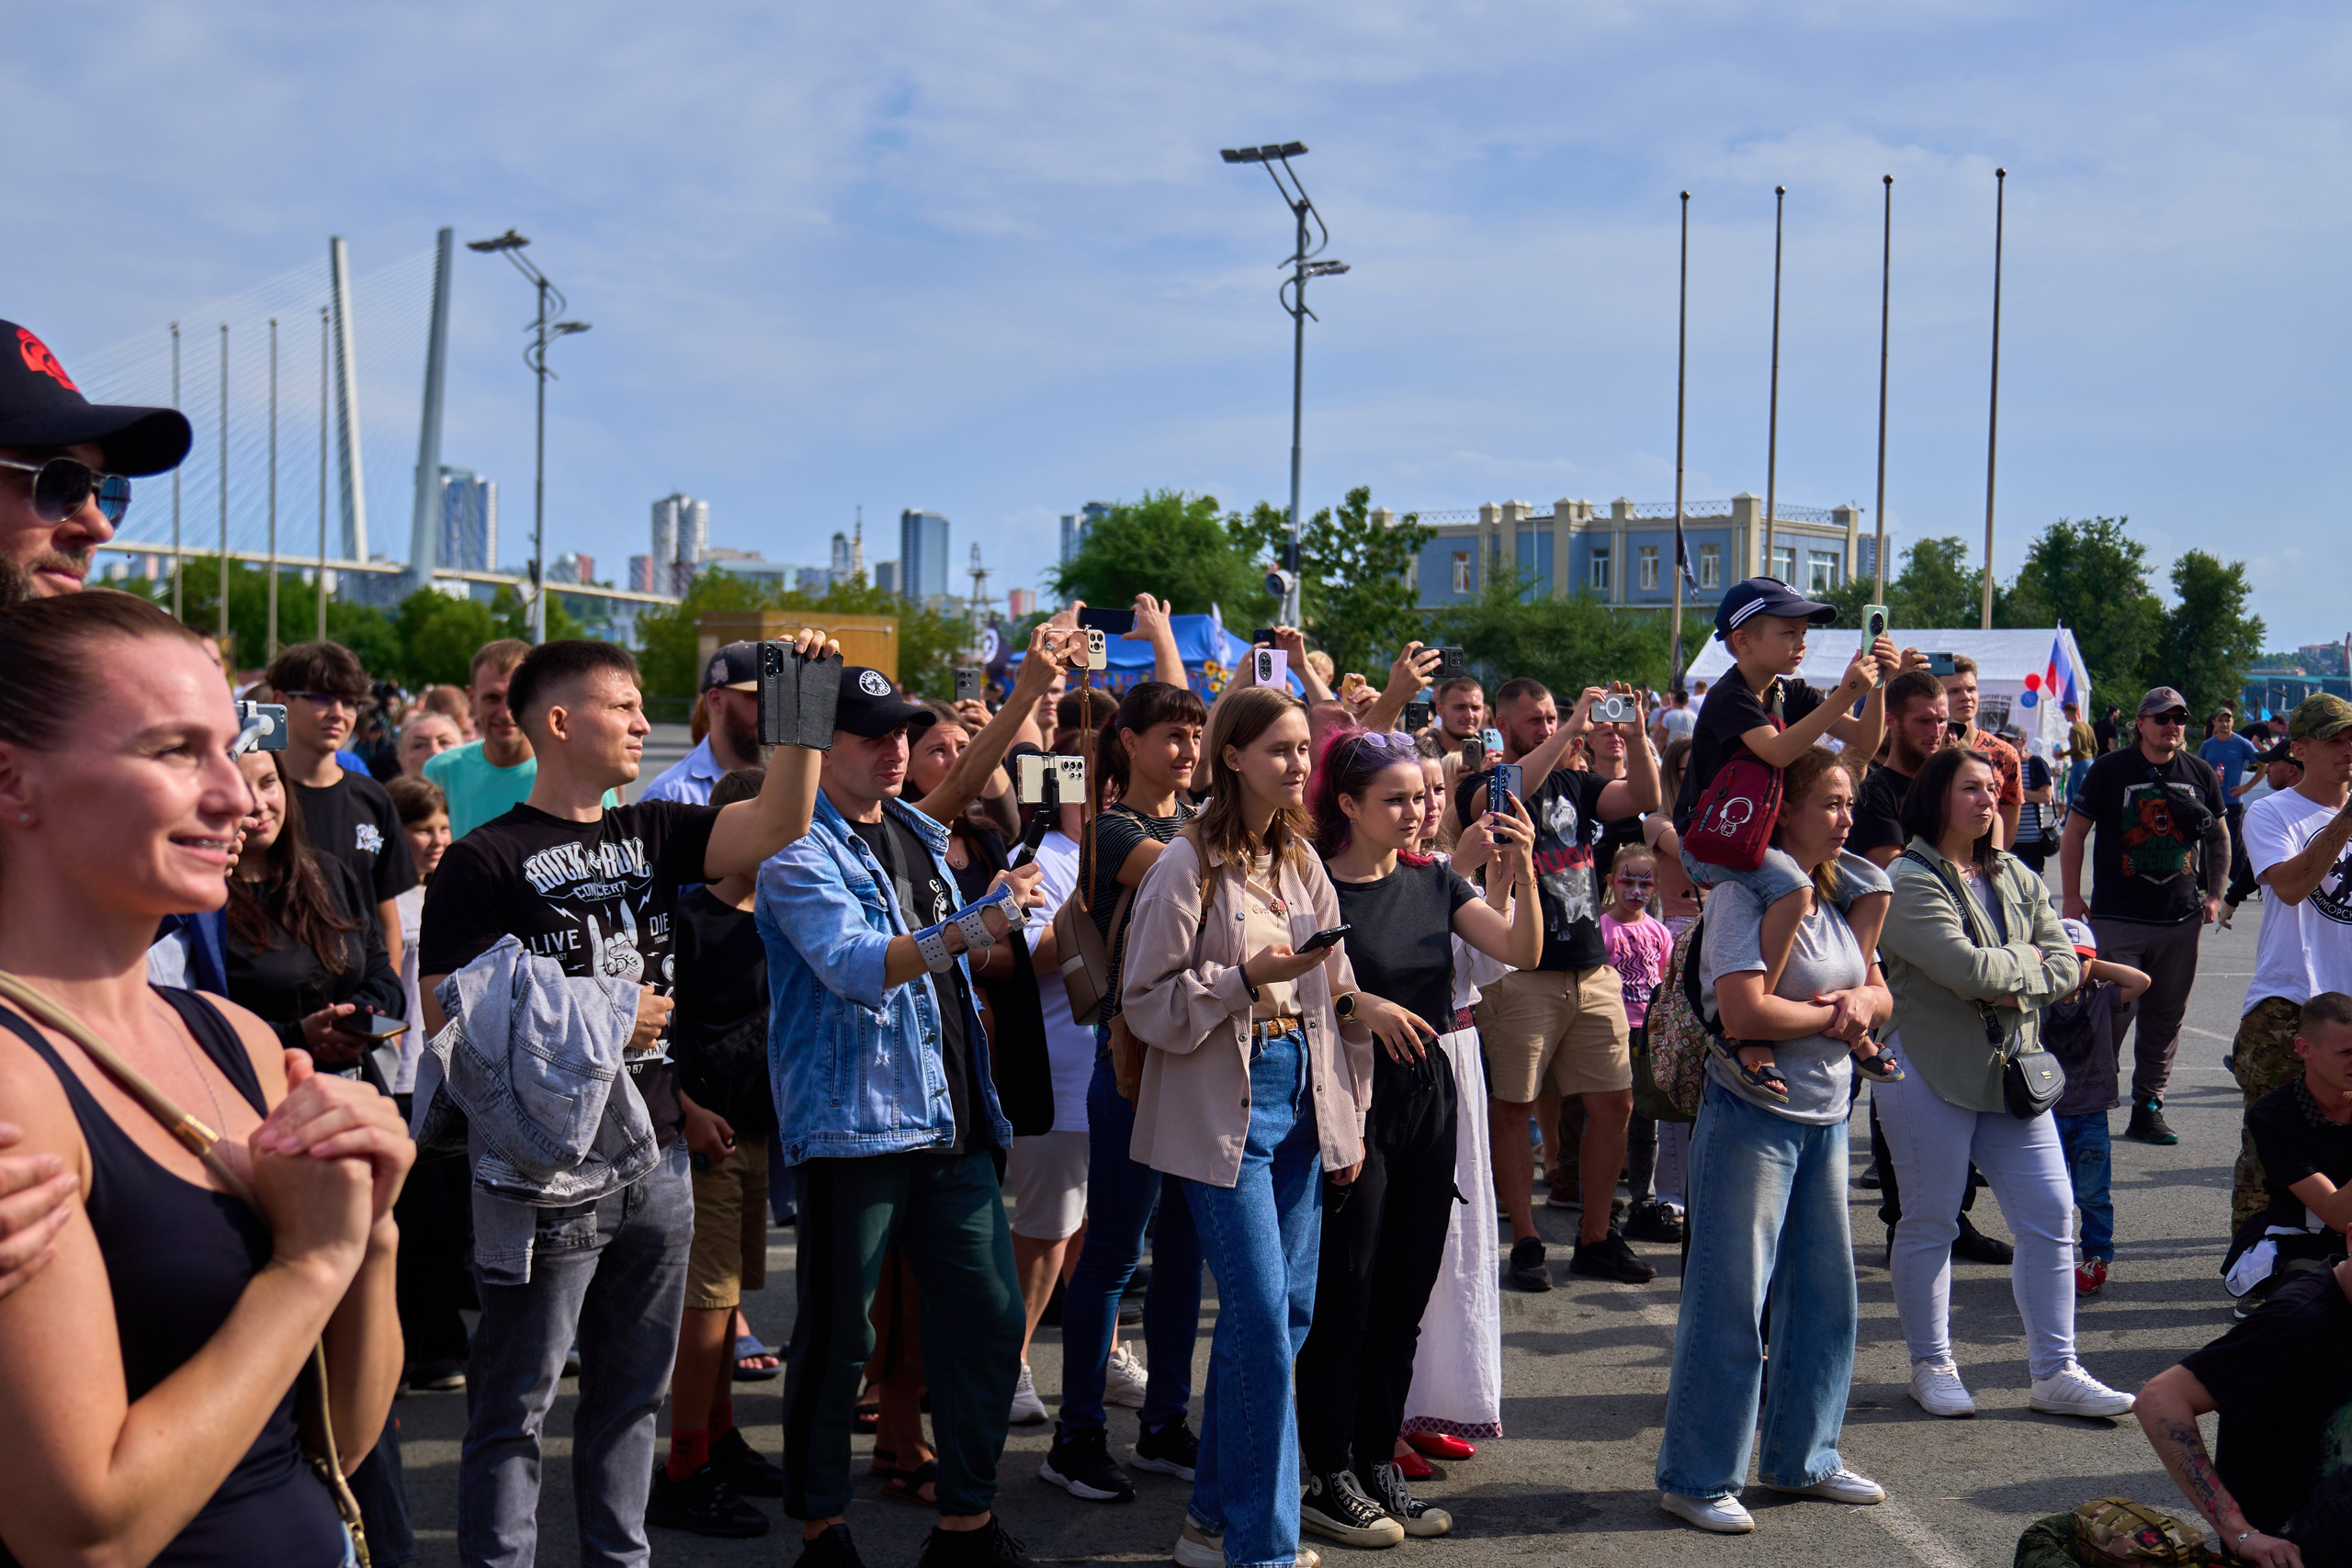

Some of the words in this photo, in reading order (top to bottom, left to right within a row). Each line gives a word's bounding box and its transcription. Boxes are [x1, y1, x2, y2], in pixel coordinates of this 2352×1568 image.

[525, 842, 592, 894] ROCK
[1532, 843, 1594, 875] HUGO
[1907, 852, 1932, 870] GUESS
[1950, 892, 1967, 920] GUESS
[2312, 889, 2352, 919] РИМОРС
[649, 912, 670, 936] DIE
[530, 929, 582, 955] LIVE
